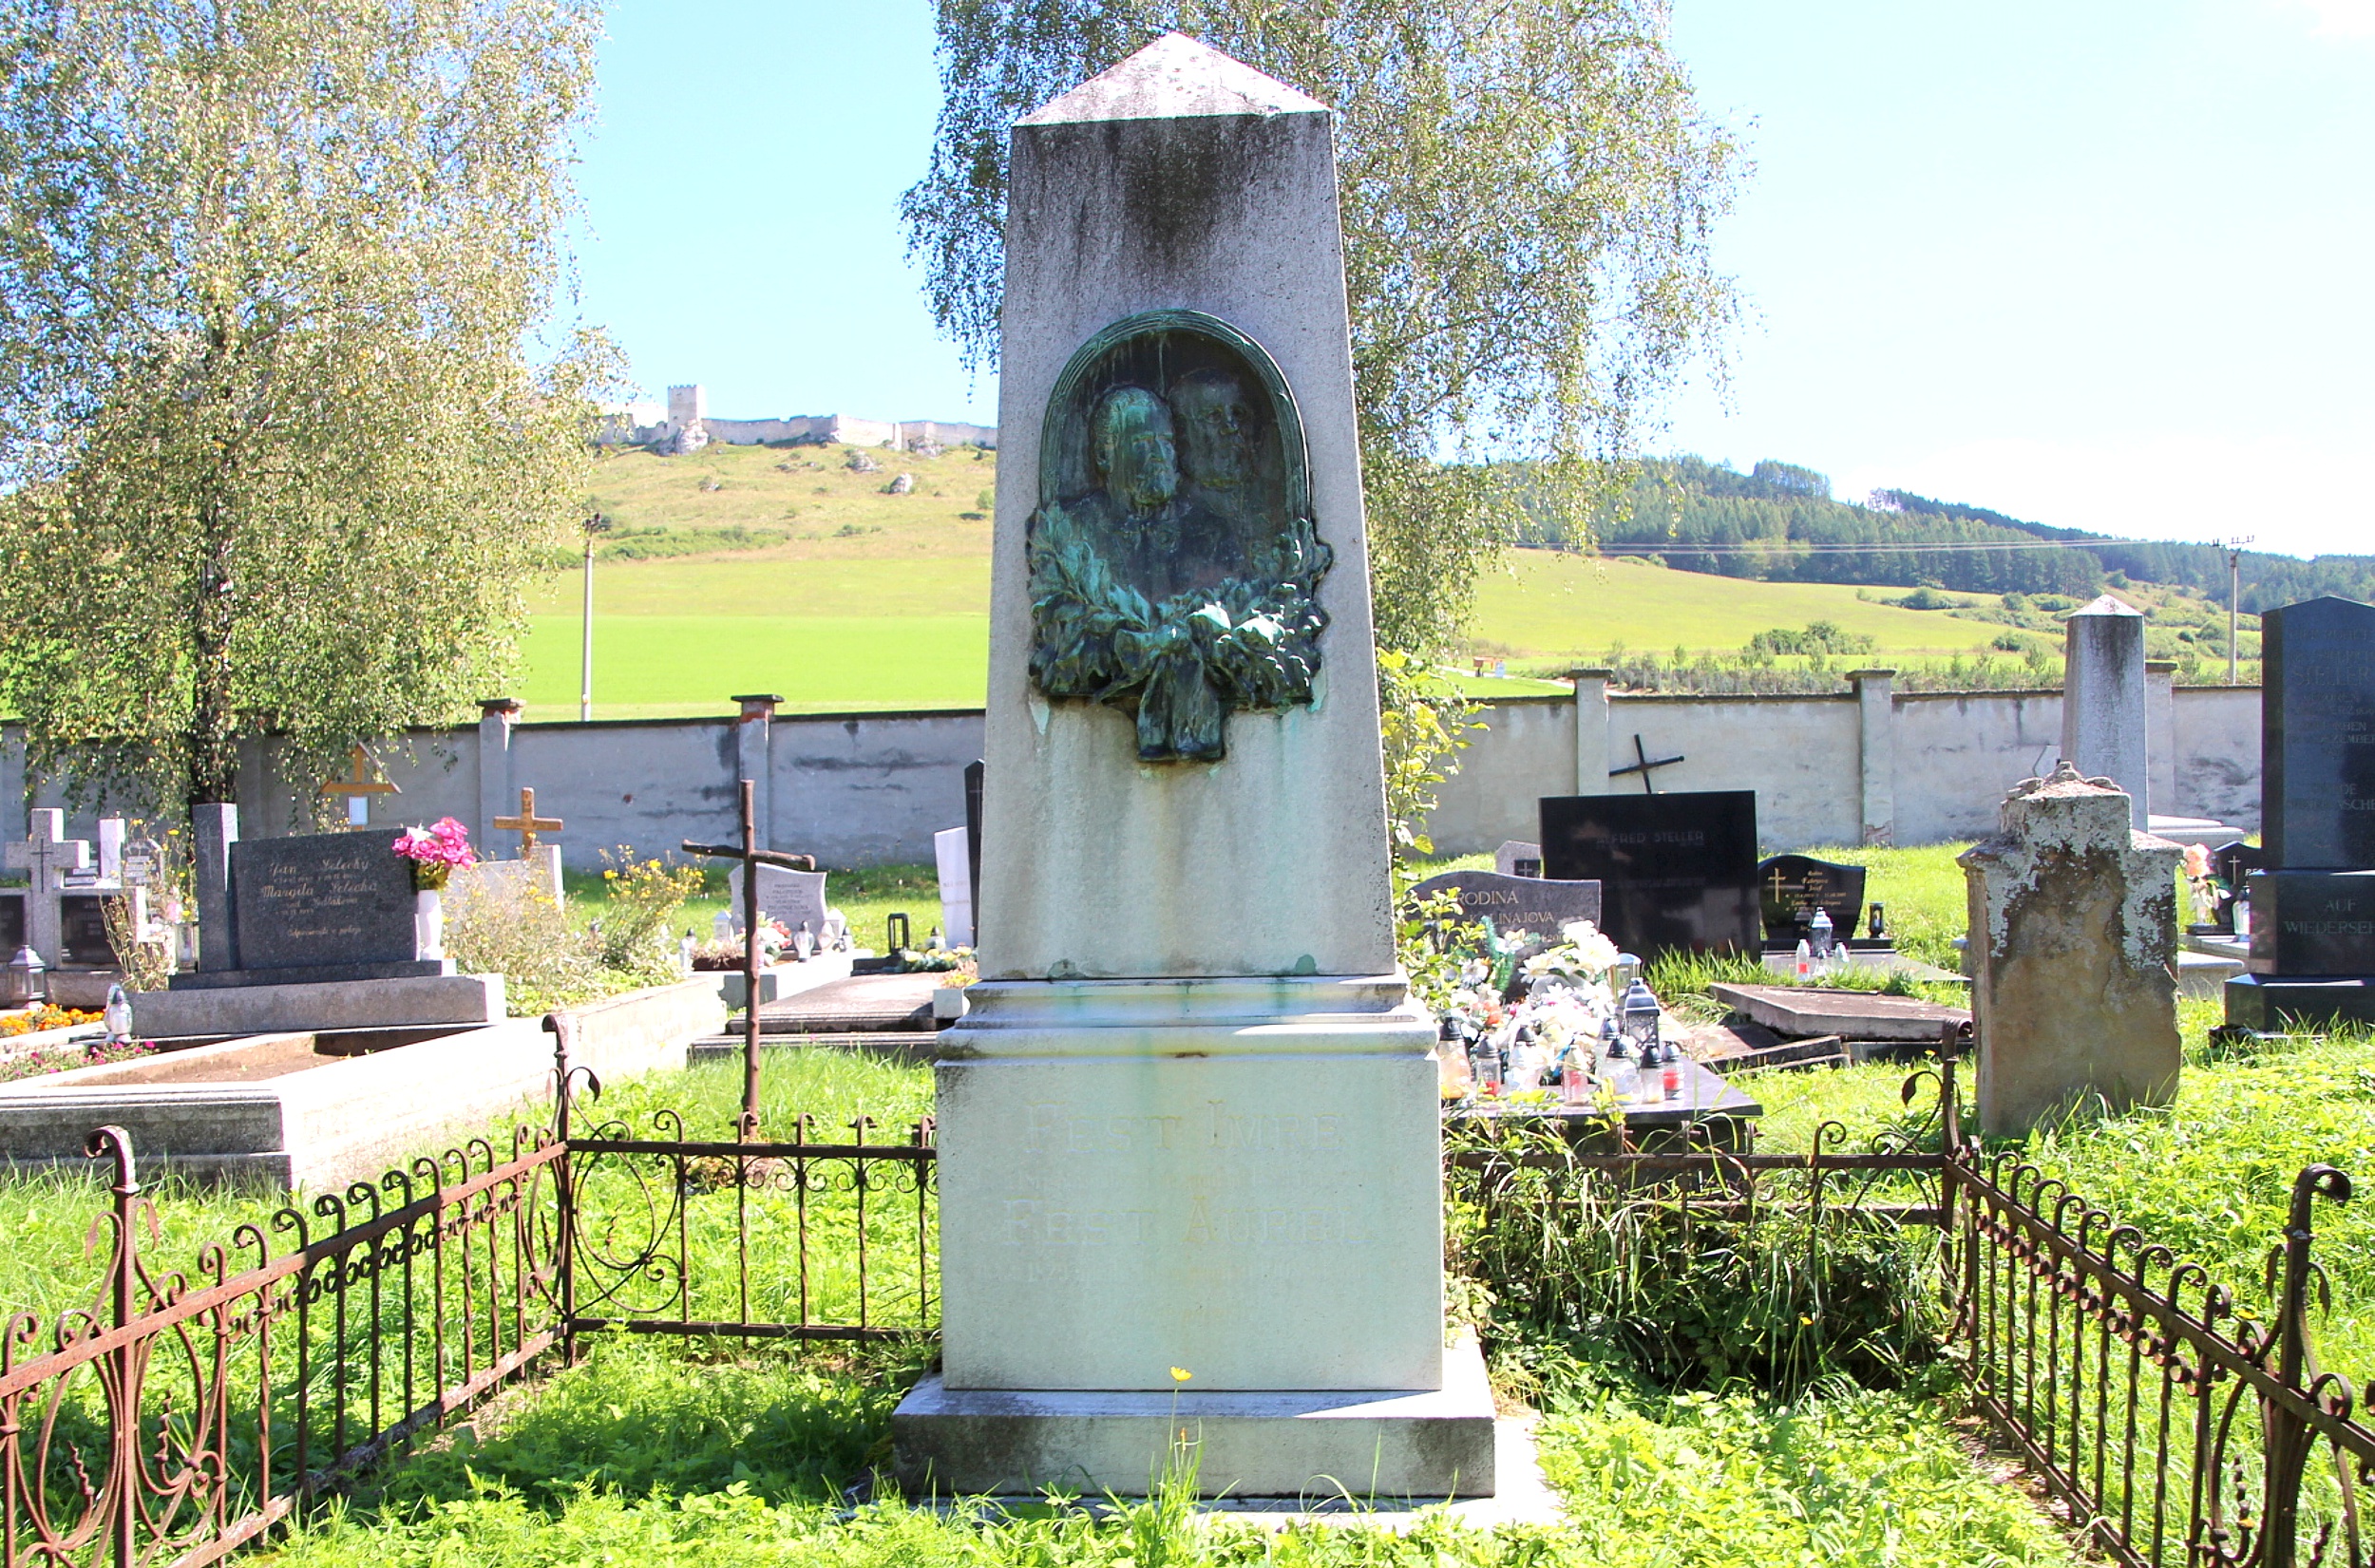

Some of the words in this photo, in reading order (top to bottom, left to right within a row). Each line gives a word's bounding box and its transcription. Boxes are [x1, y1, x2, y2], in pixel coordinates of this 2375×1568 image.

[1455, 890, 1520, 906] RODINA
[2325, 898, 2357, 912] AUF
[1469, 911, 1555, 925] KLINAJOVA
[1023, 1099, 1185, 1154] FEST
[1205, 1098, 1346, 1152] IMRE
[1003, 1194, 1159, 1245] FEST
